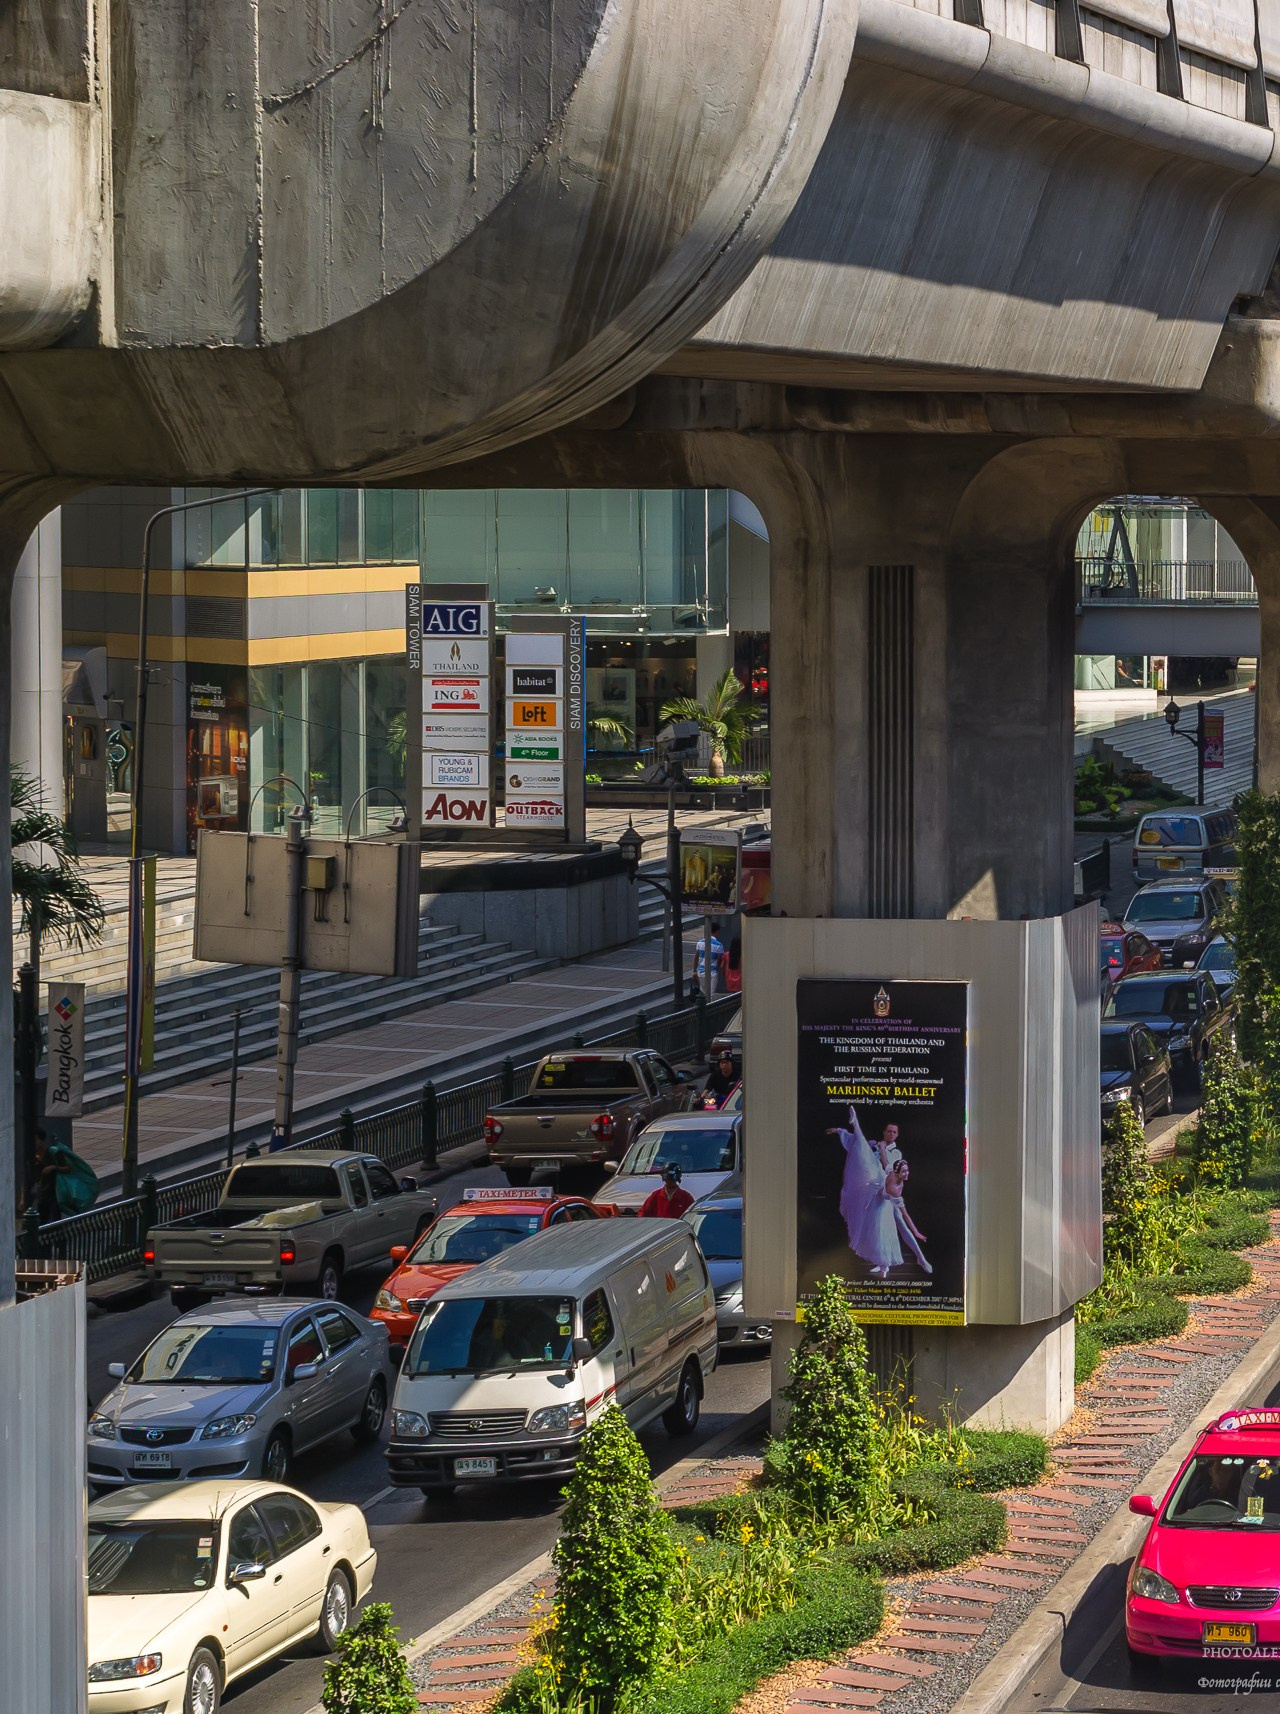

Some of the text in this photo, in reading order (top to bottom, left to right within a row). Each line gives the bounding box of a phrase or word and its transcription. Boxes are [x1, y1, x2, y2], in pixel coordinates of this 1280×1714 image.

[426, 607, 478, 632] AIG
[409, 586, 420, 669] SIAM TOWER
[432, 663, 479, 671] THAILAND
[570, 618, 581, 729] SIAM DISCOVERY
[517, 677, 546, 686] habitat
[434, 690, 459, 700] ING
[438, 758, 466, 766] YOUNG
[438, 775, 470, 783] BRANDS
[506, 806, 563, 816] OUTBACK
[819, 1036, 945, 1047] THE KINGDOM OF THAILAND AND
[833, 1045, 850, 1053] THE
[883, 1046, 931, 1054] FEDERATION
[52, 1023, 78, 1104] Bangkok
[871, 1056, 892, 1064] present
[878, 1066, 888, 1074] IN
[889, 1066, 930, 1075] THAILAND
[819, 1075, 851, 1083] Spectacular
[890, 1076, 898, 1084] by
[826, 1085, 937, 1097] MARIINSKY BALLET
[479, 1189, 538, 1198] TAXI-METER
[472, 1460, 493, 1469] 8451
[1228, 1626, 1247, 1637] 960
